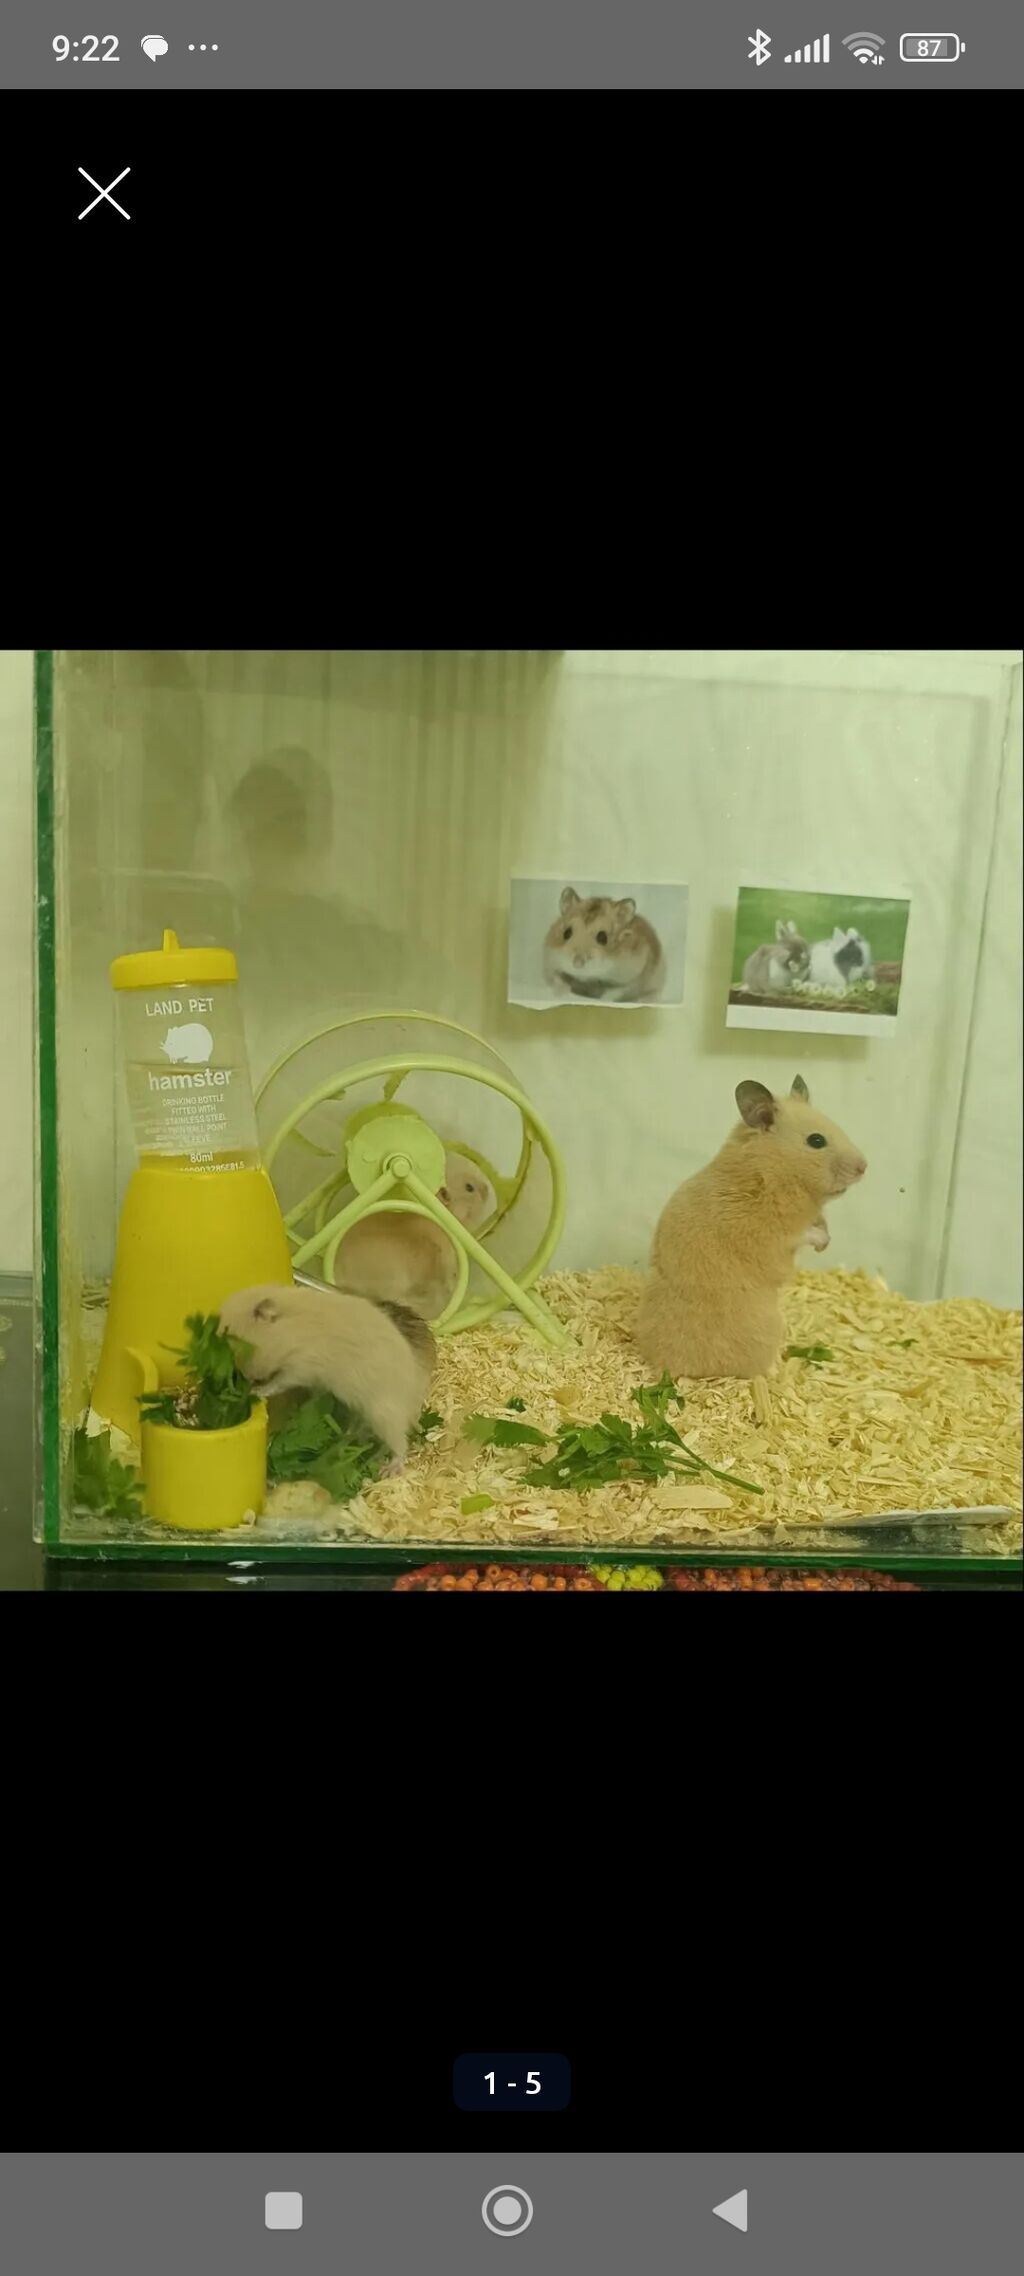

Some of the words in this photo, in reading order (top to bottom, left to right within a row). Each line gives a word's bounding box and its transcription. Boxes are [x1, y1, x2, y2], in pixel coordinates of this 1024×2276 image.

[145, 1000, 183, 1016] LAND
[189, 998, 214, 1013] PET
[148, 1068, 231, 1091] hamster
[161, 1096, 196, 1106] DRINKING
[198, 1094, 224, 1104] BOTTLE
[171, 1106, 197, 1115] FITTED
[198, 1104, 216, 1114] WITH
[165, 1114, 204, 1125] STAINLESS
[206, 1113, 225, 1122] STEEL
[190, 1152, 213, 1163] 80ml
